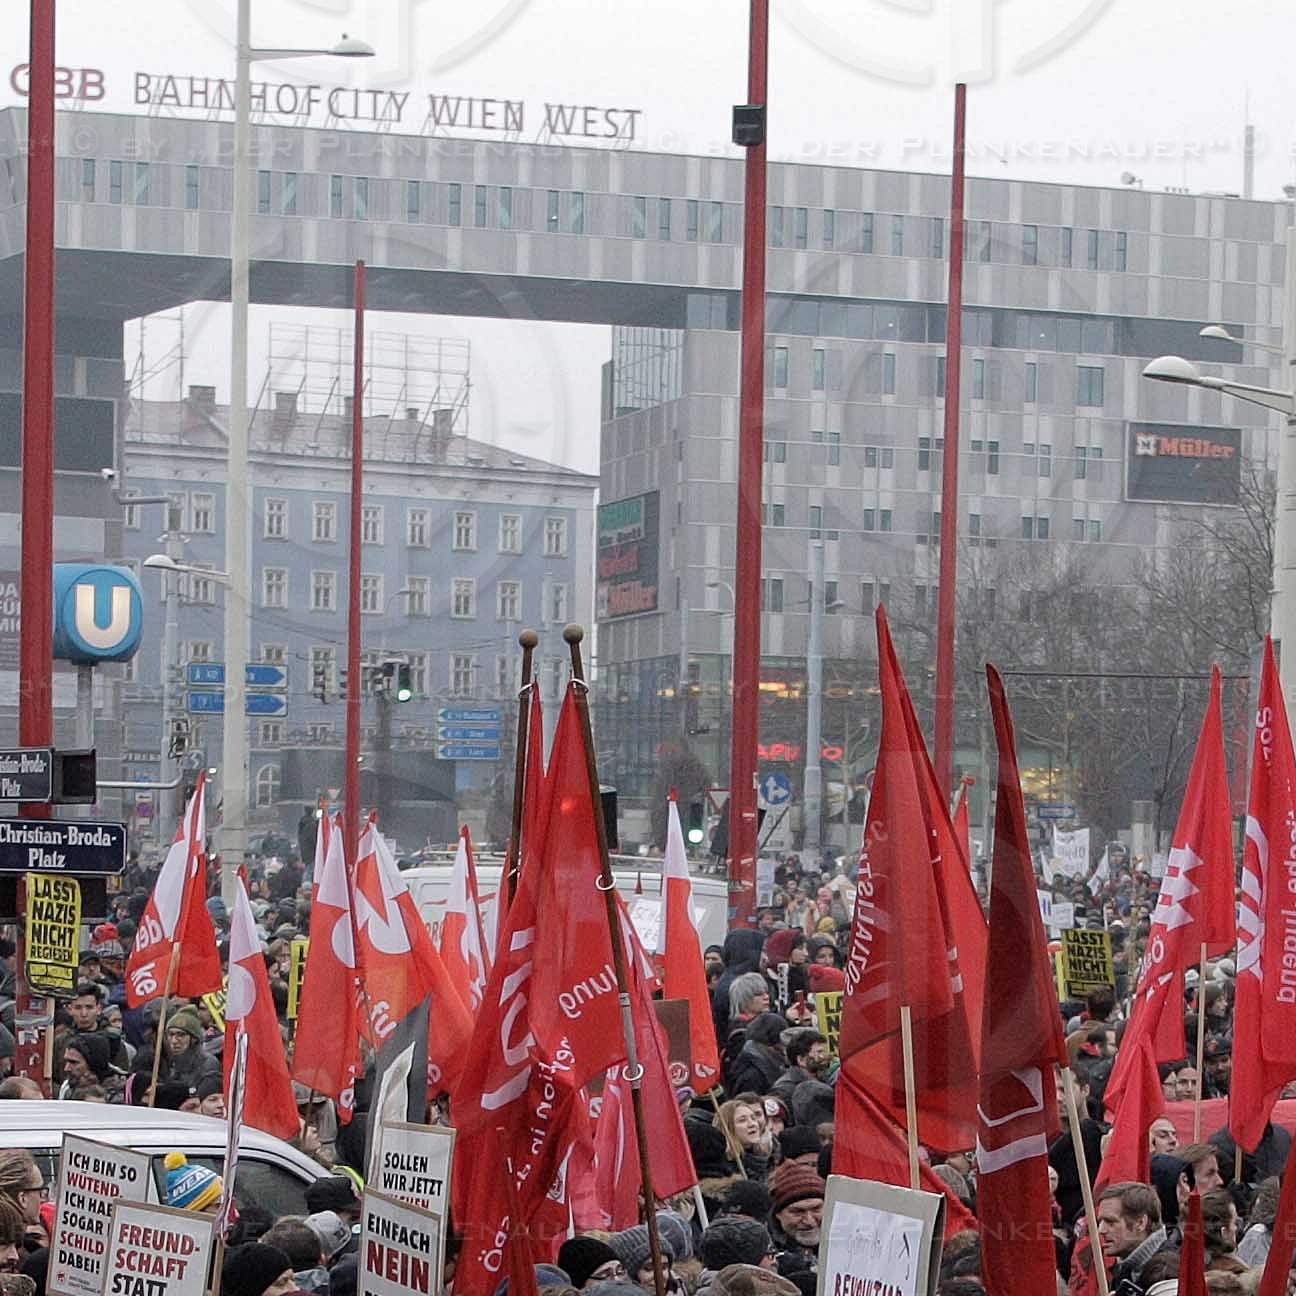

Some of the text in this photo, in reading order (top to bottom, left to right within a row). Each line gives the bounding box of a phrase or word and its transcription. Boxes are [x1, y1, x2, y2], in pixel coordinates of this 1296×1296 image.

[134, 71, 410, 123] BAHNHOFCITY
[430, 94, 524, 132] WIEN
[545, 103, 643, 141] WEST
[1160, 434, 1234, 459] Müller
[76, 584, 131, 650] U
[1, 779, 21, 798] Platz
[28, 848, 66, 868] Platz
[34, 878, 78, 902] LASST
[32, 901, 76, 924] NAZIS
[32, 923, 75, 948] NICHT
[68, 1151, 137, 1182] ICH BIN SO
[384, 1151, 429, 1174] SOLLEN
[67, 1168, 124, 1199] WÜTEND.
[383, 1172, 443, 1197] WIR JETZT
[64, 1190, 86, 1210] ICH
[62, 1211, 103, 1235] SOGAR
[367, 1213, 431, 1254] EINFACH
[59, 1230, 105, 1256] SCHILD
[117, 1223, 202, 1257] FREUND-
[58, 1250, 101, 1275] DABEI!
[114, 1247, 188, 1281] SCHAFT
[366, 1239, 430, 1295] NEIN
